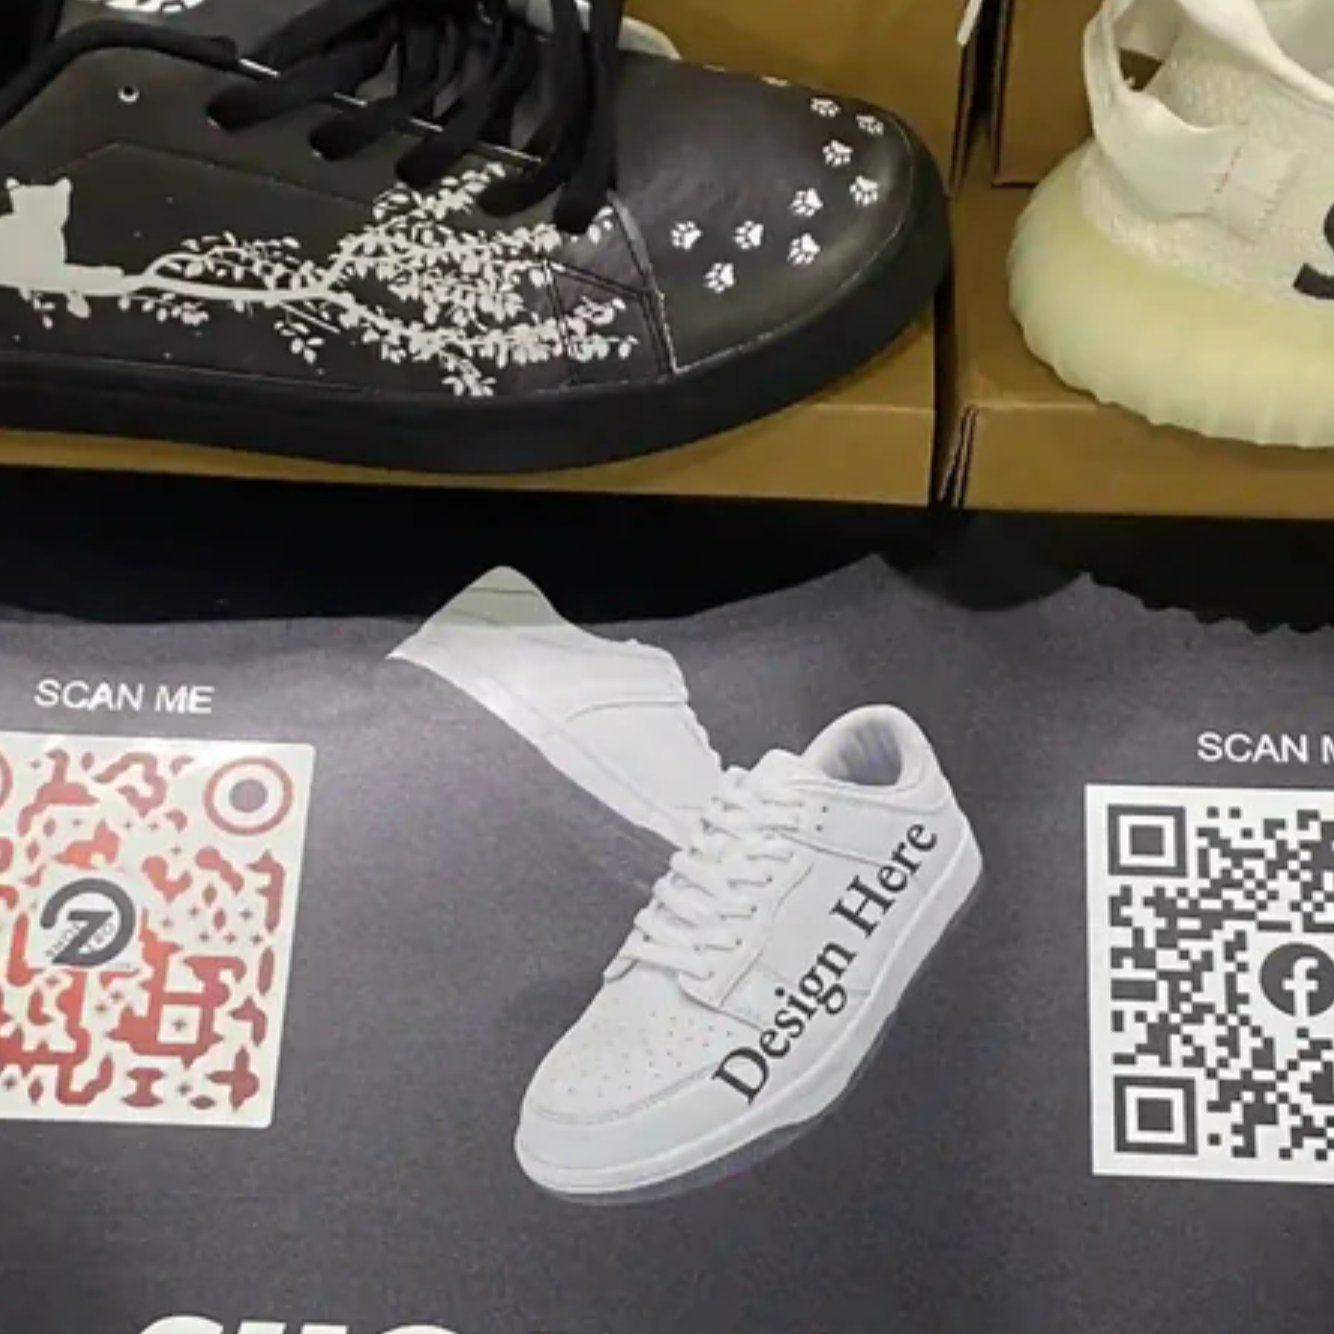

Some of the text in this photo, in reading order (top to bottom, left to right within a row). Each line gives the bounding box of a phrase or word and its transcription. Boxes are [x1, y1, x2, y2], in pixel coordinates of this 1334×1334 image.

[32, 677, 215, 714] SCAN ME
[1196, 731, 1309, 764] SCAN
[711, 821, 939, 1105] Design Here
